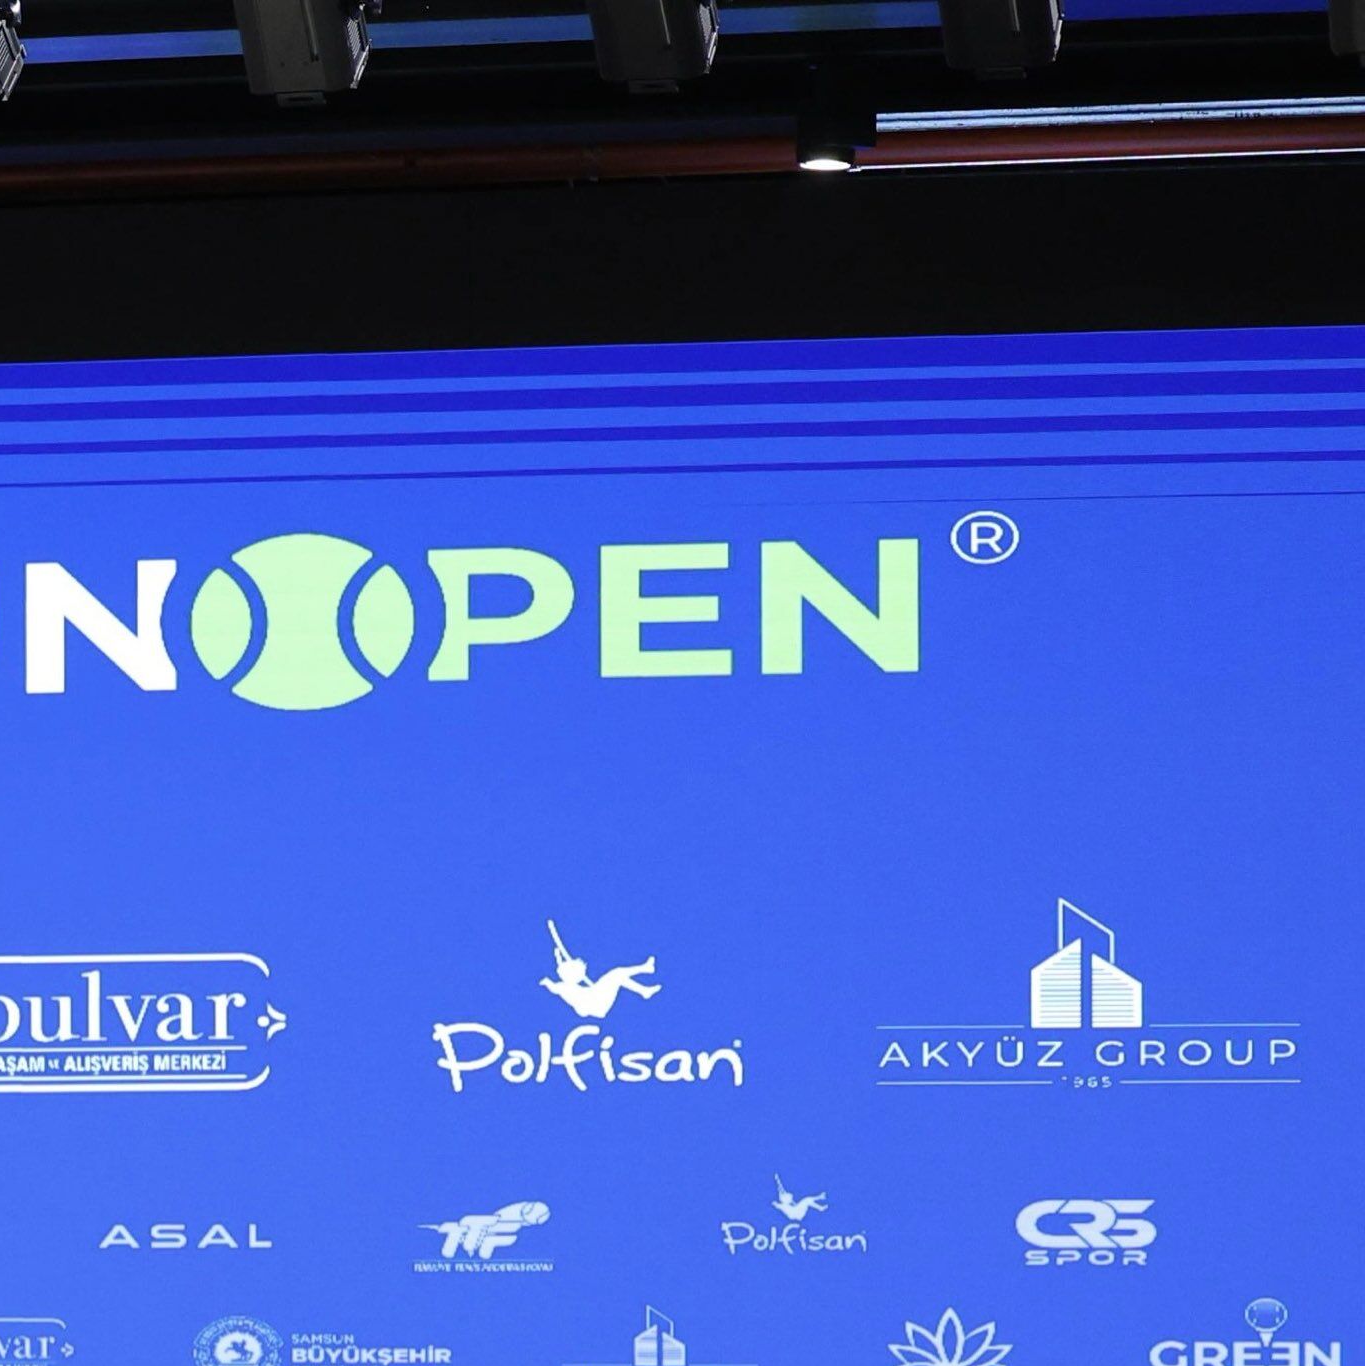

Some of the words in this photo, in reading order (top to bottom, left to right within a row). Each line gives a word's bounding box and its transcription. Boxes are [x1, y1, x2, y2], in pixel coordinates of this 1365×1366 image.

[64, 1051, 149, 1076] ALIŞVERİŞ
[154, 1050, 227, 1071] MERKEZİ
[433, 1023, 742, 1092] Polfisan
[880, 1036, 1063, 1067] AKYÜZ
[1096, 1040, 1295, 1066] GROUP
[100, 1224, 272, 1248] ASAL
[721, 1222, 866, 1254] Polfisan
[1025, 1250, 1147, 1265] SPOR
[292, 1334, 356, 1344] SAMSUN
[292, 1345, 451, 1366] BÜYÜKŞEHİR
